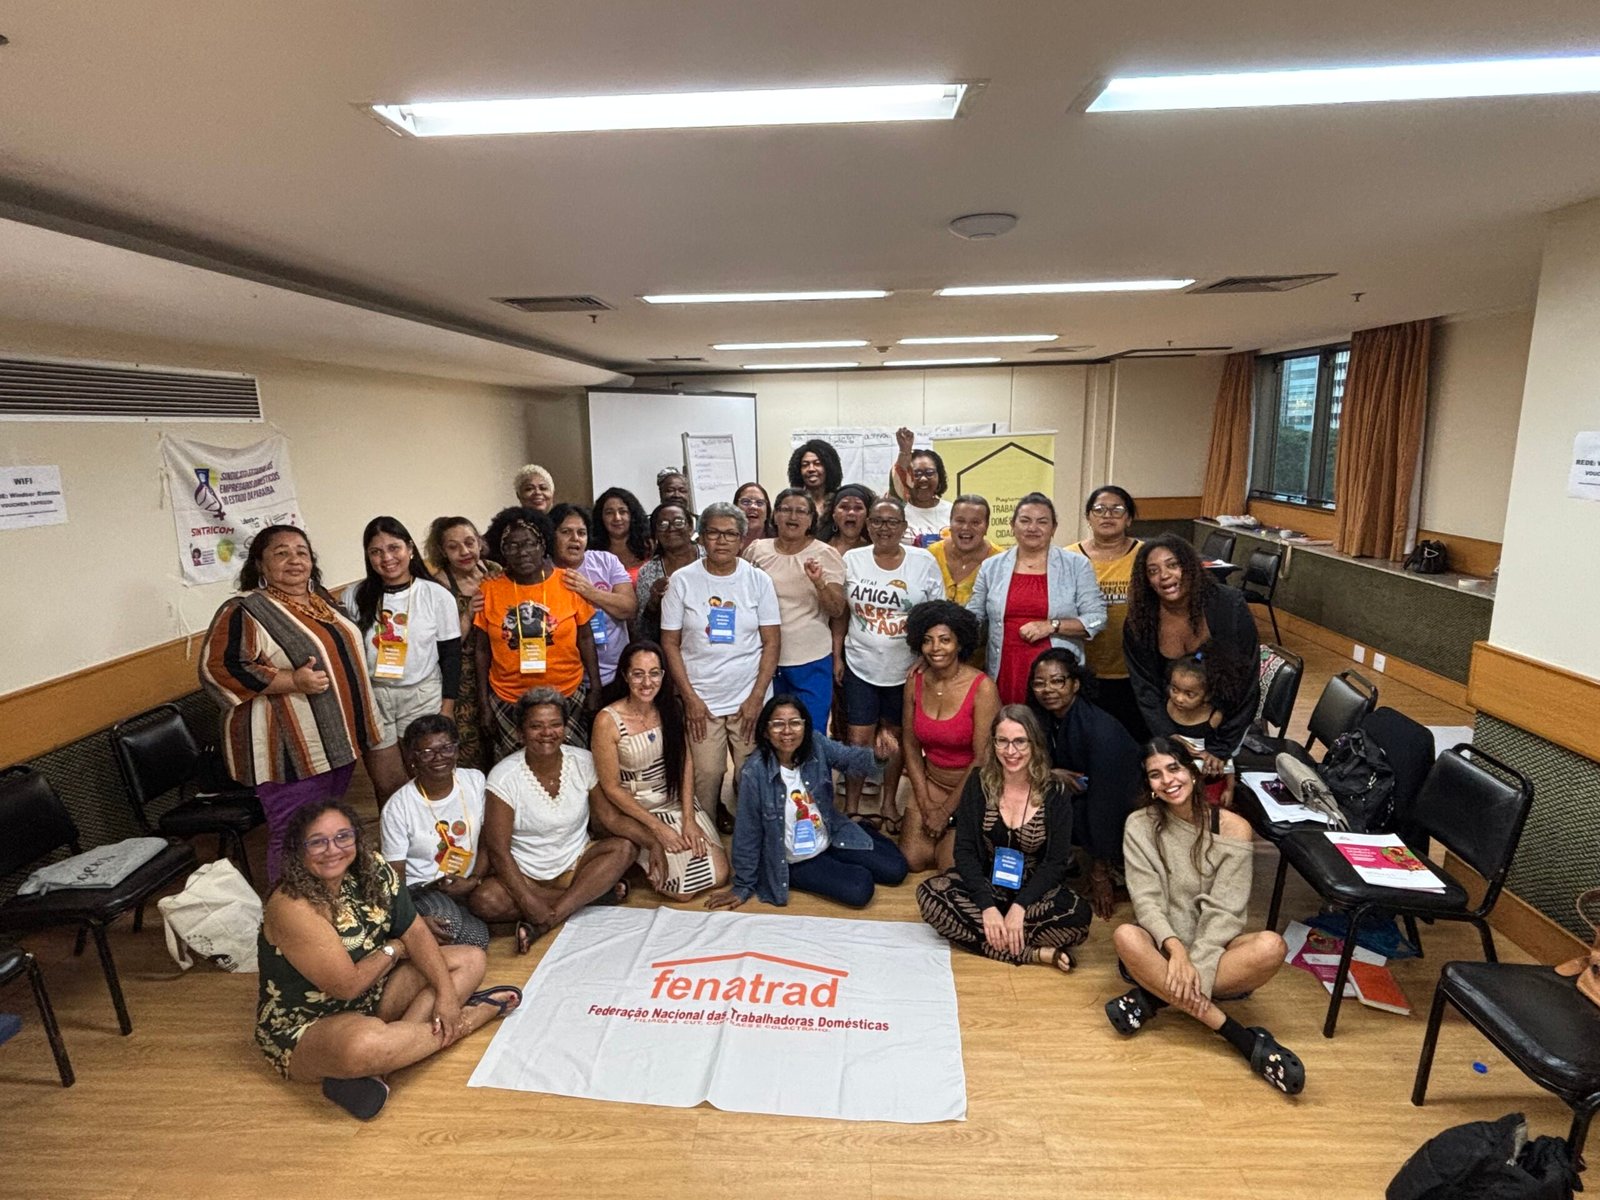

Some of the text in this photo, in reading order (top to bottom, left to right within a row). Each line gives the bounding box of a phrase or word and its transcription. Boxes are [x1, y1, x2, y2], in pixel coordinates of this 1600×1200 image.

[13, 477, 33, 485] WIFI
[850, 585, 901, 608] AMIGA
[650, 969, 839, 1008] fenatrad
[588, 1004, 890, 1031] Federação Nacional das Trabalhadoras Domésticas
